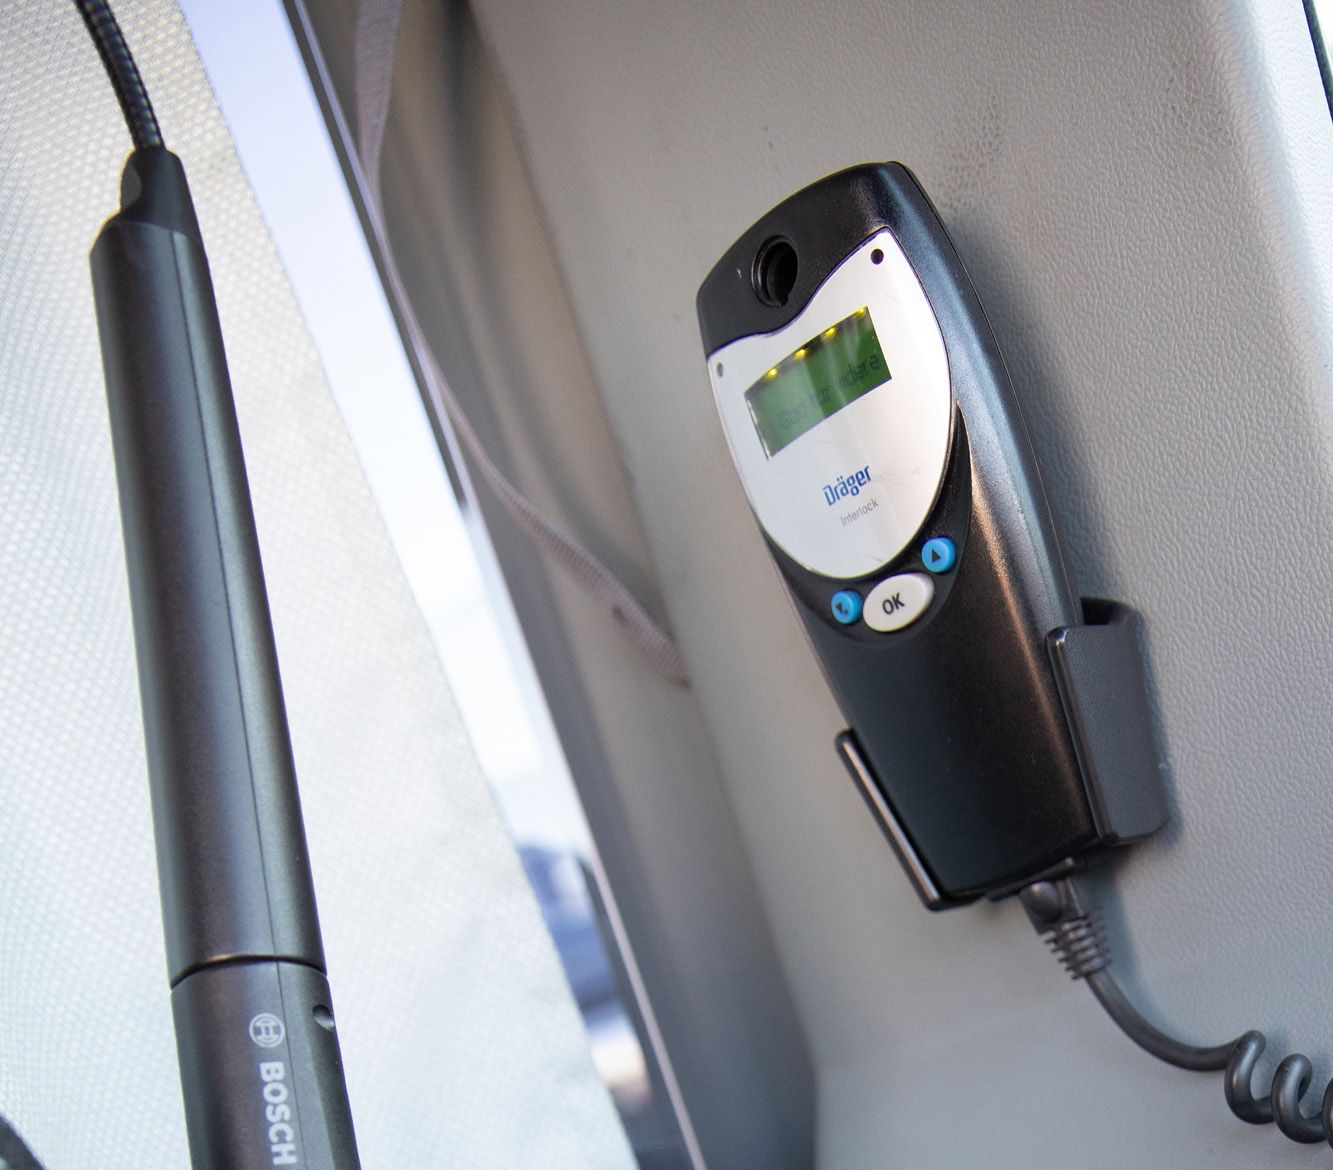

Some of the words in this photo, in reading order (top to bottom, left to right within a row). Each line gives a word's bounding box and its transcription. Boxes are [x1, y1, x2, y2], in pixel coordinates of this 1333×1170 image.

[822, 465, 872, 507] Dräger
[840, 497, 879, 527] Interlock
[882, 592, 905, 614] OK
[259, 1061, 298, 1165] BOSCH
